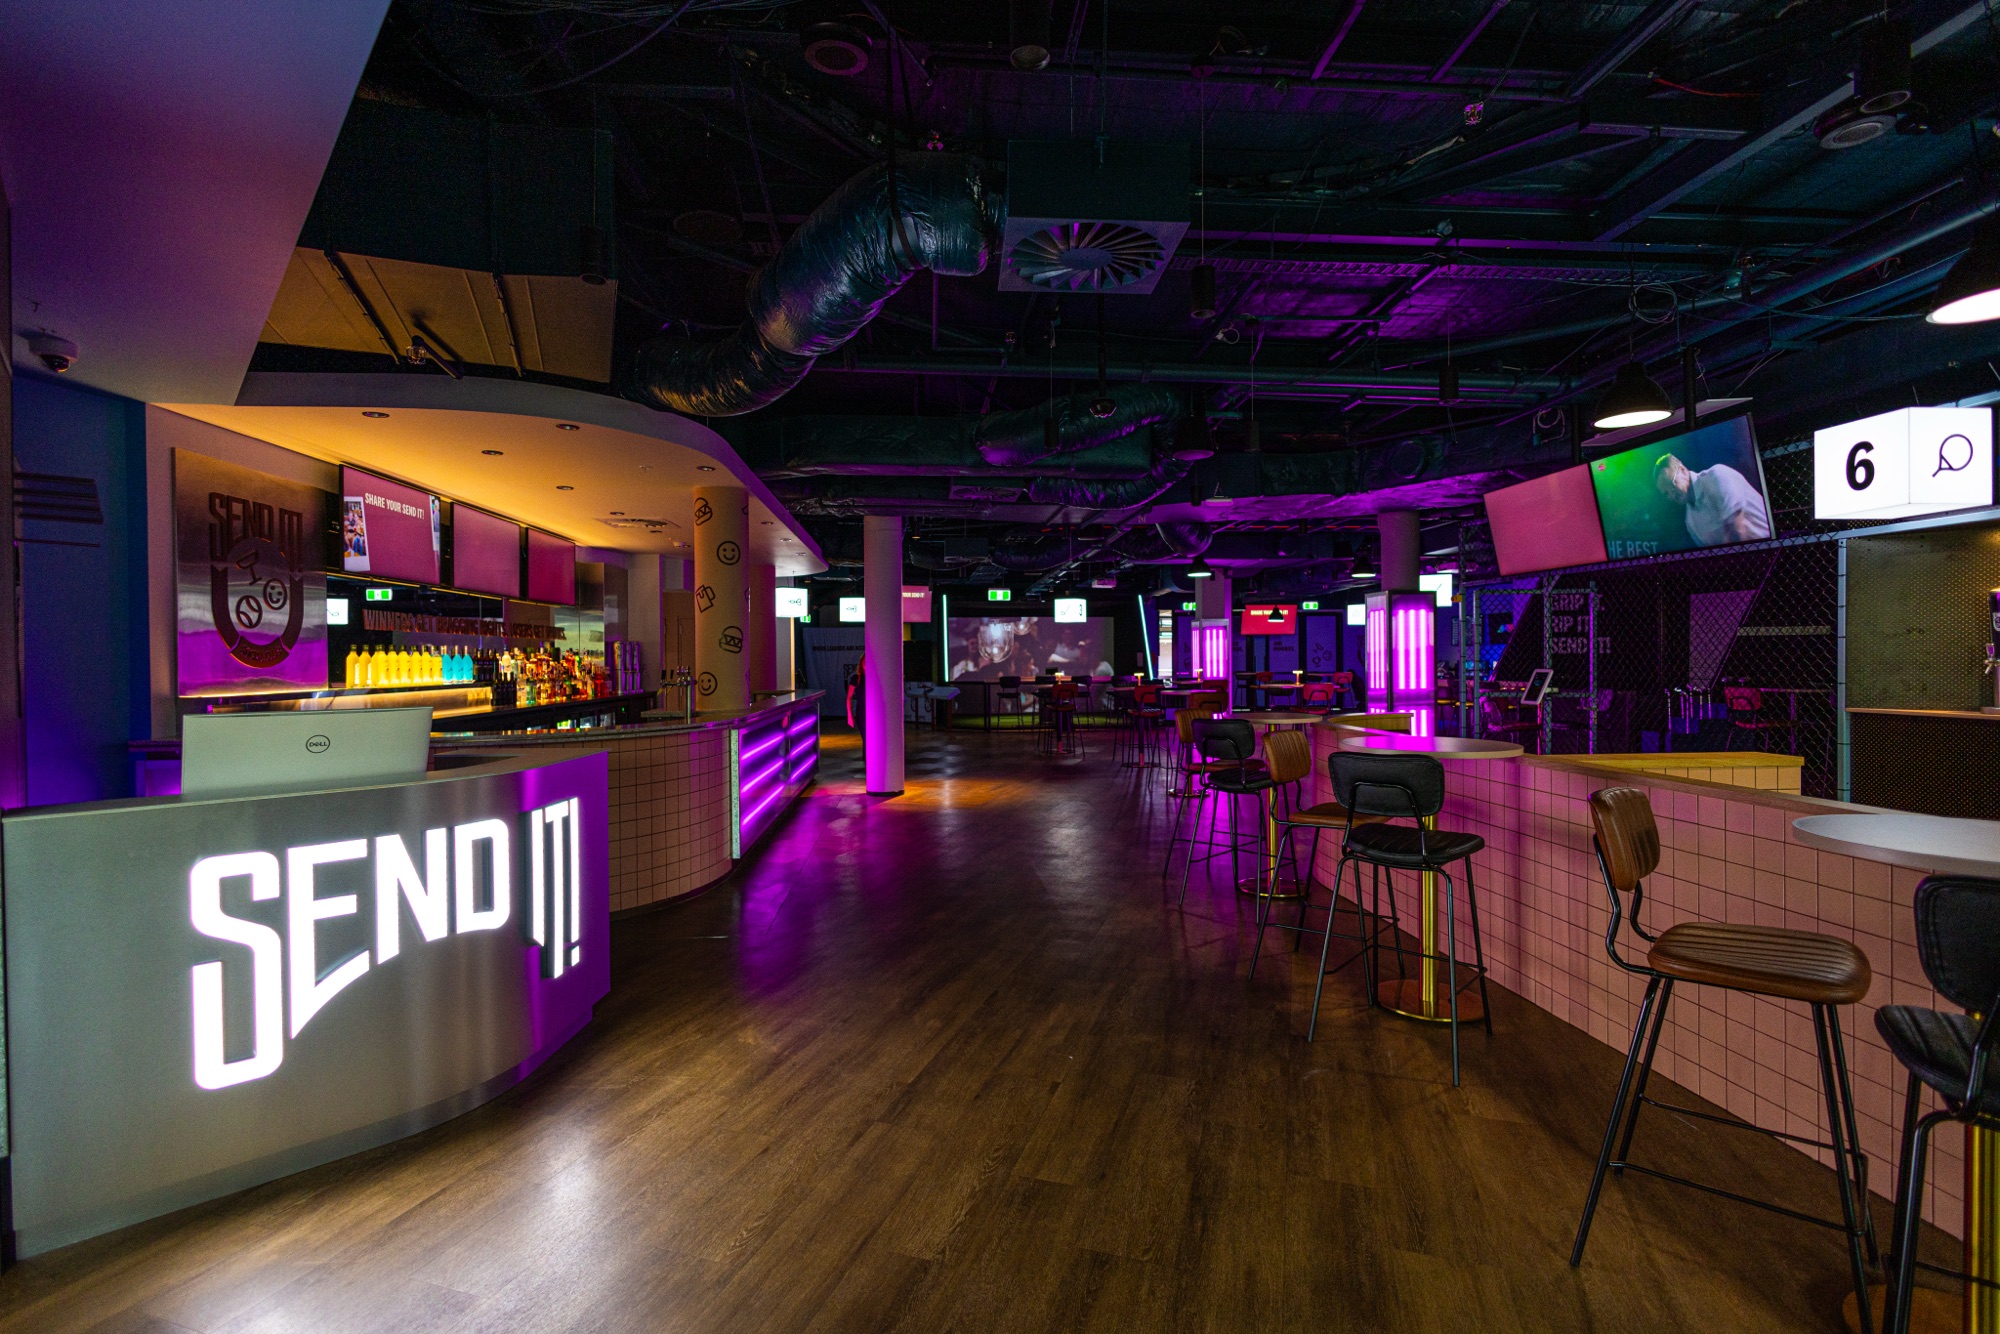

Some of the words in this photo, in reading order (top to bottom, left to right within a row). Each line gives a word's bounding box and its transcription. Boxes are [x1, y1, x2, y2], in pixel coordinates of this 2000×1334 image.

[1846, 441, 1875, 491] 6
[364, 492, 386, 509] SHARE
[386, 498, 402, 513] YOUR
[402, 504, 417, 518] SEND
[417, 508, 425, 520] IT!
[208, 492, 274, 562] SEND
[1607, 540, 1623, 559] HE
[1626, 541, 1658, 558] BEST
[362, 609, 412, 632] WINNERS
[415, 613, 433, 633] GET
[1551, 637, 1588, 654] SEND
[190, 818, 511, 1090] SEND
[528, 797, 581, 980] IT!
